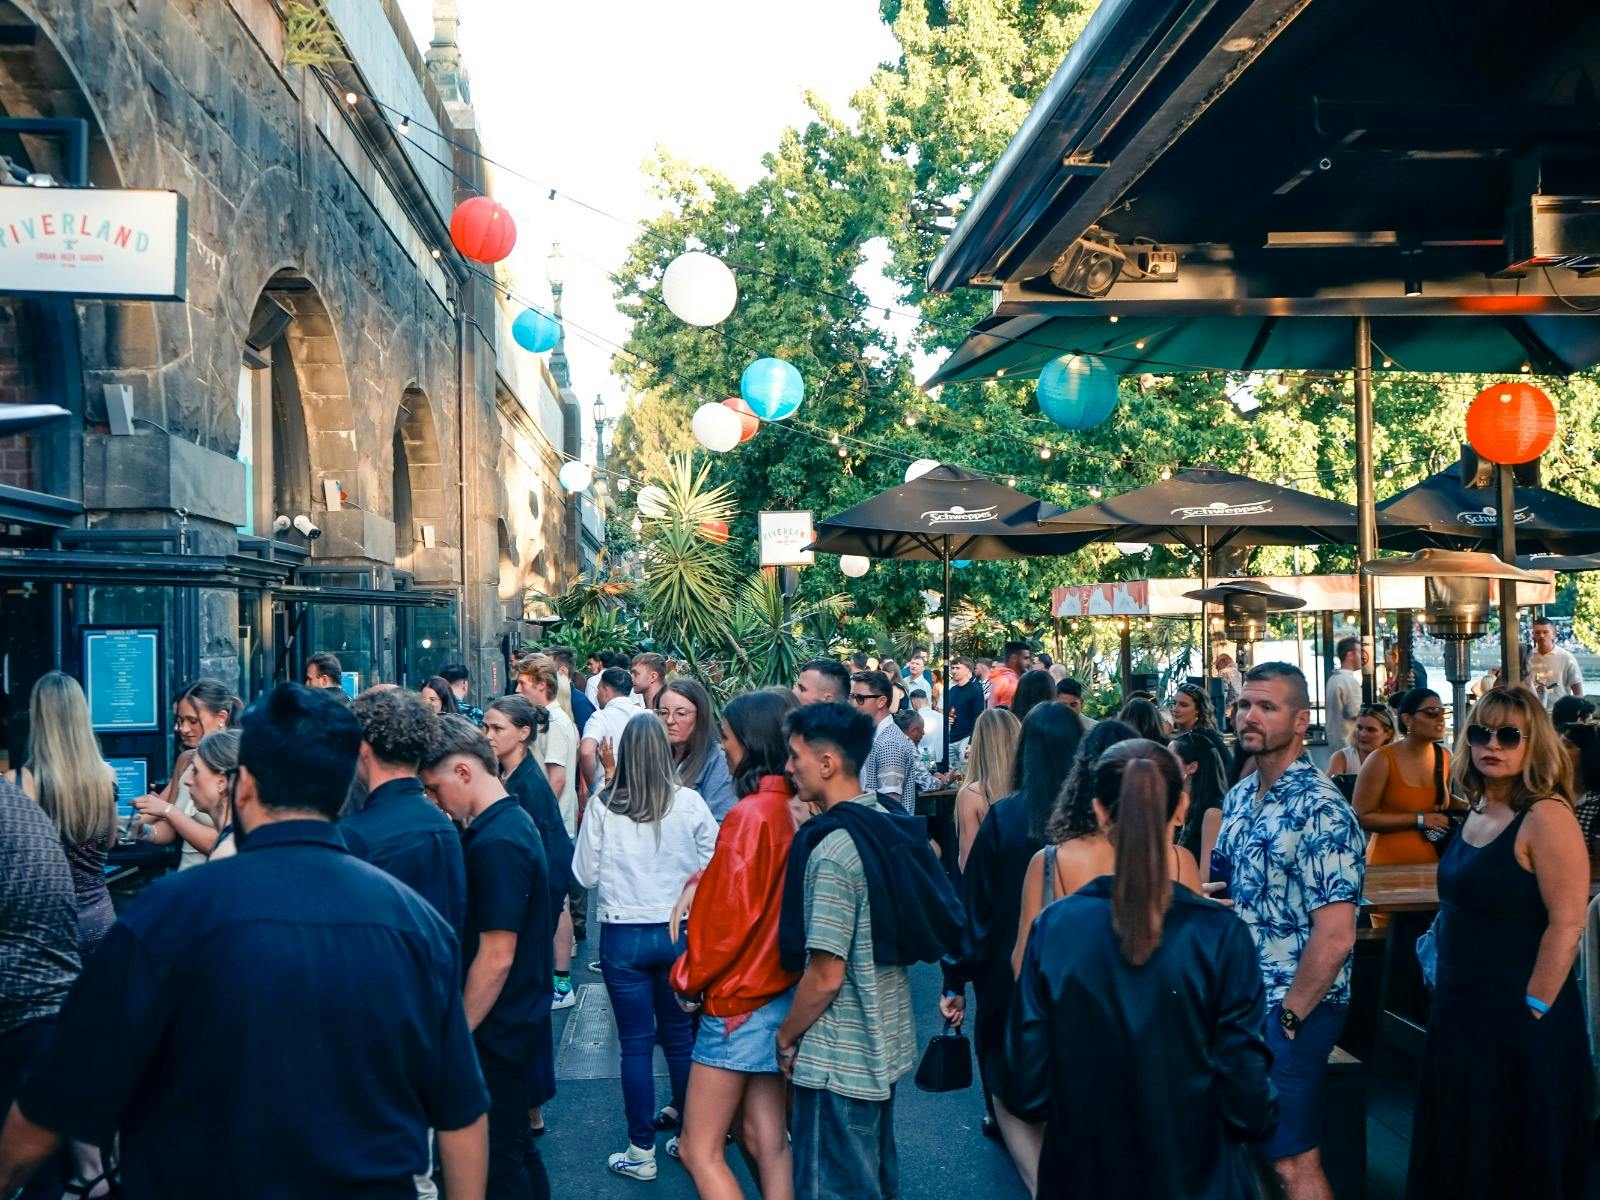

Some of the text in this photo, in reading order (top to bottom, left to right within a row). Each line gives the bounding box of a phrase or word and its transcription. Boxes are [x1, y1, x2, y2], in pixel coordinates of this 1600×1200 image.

[929, 511, 992, 521] Schweppes
[1182, 505, 1265, 516] Schweppes
[1465, 512, 1526, 524] Schwes
